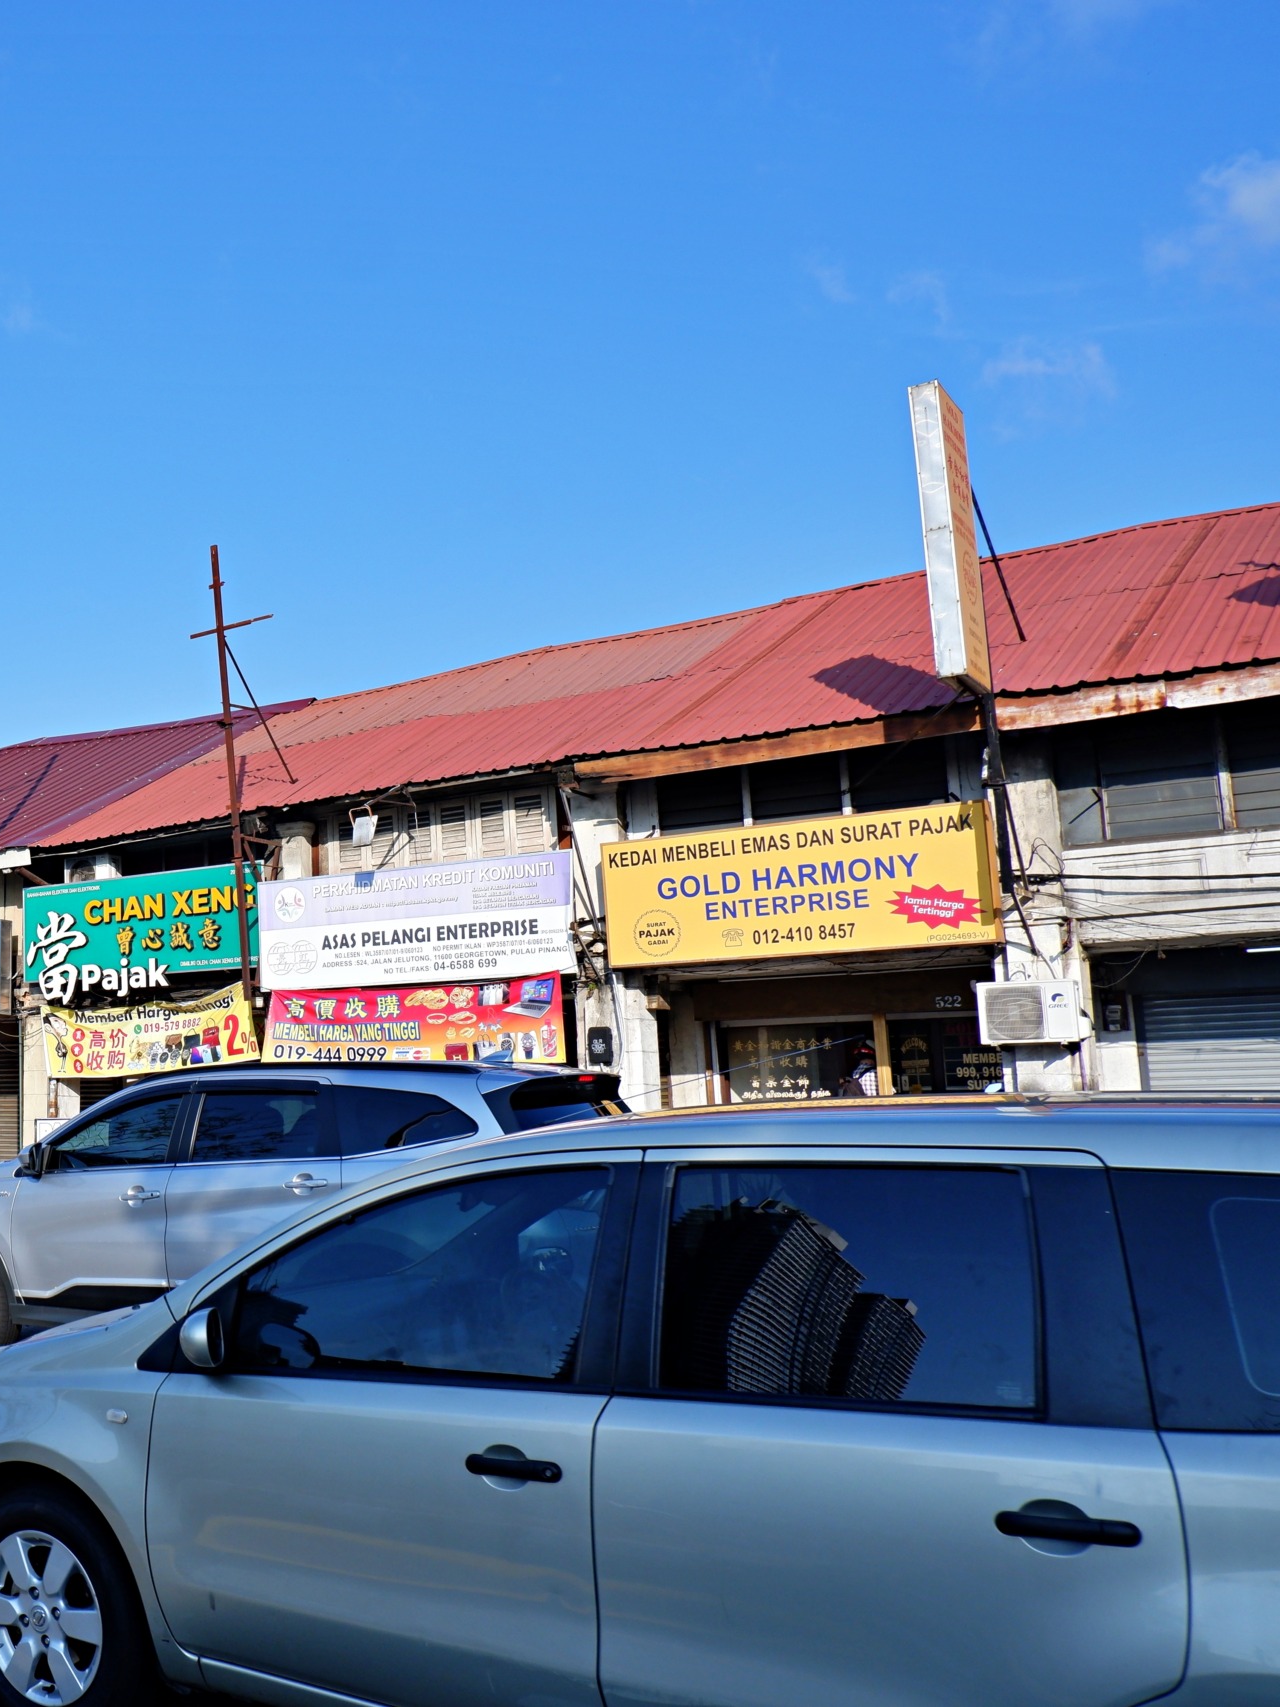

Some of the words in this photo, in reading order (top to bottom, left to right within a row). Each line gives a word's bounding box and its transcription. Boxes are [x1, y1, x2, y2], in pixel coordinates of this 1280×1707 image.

[608, 848, 657, 868] KEDAI
[662, 840, 736, 862] MENBELI
[741, 834, 790, 854] EMAS
[796, 828, 834, 848] DAN
[840, 821, 902, 844] SURAT
[909, 813, 972, 836] PAJAK
[312, 876, 418, 898] PERKHIDMATAN
[422, 870, 476, 888] KREDIT
[479, 862, 554, 882] KOMUNITI
[657, 870, 740, 900] GOLD
[752, 853, 919, 891] HARMONY
[84, 893, 164, 924] CHAN
[172, 884, 254, 916] XENG
[705, 888, 870, 921] ENTERPRISE
[904, 896, 931, 906] Jamin
[934, 898, 964, 910] Harga
[912, 905, 955, 918] Tertinggi
[116, 918, 220, 956] 曾心誠意
[322, 933, 356, 950] ASAS
[362, 926, 430, 947] PELANGI
[436, 918, 538, 942] ENTERPRISE
[638, 928, 676, 938] PAJAK
[752, 926, 812, 944] 012-410
[819, 923, 856, 940] 8457
[926, 932, 990, 942] (PG0254693-V)
[27, 911, 87, 1005] 當
[434, 960, 474, 971] 04-6588
[478, 958, 497, 968] 699
[82, 958, 169, 997] Pajak
[284, 994, 401, 1020] 高價收購
[935, 995, 962, 1008] 522
[144, 1022, 180, 1033] 019-579
[182, 1017, 202, 1030] 8882
[274, 1022, 318, 1040] MEMBELI
[320, 1022, 354, 1042] HARGA
[355, 1023, 382, 1042] YANG
[384, 1022, 420, 1040] TINGGI
[89, 1028, 128, 1049] 高价
[86, 1050, 126, 1070] 收购
[274, 1045, 342, 1061] 019-444
[347, 1046, 387, 1061] 0999
[956, 1067, 980, 1079] 999,
[982, 1066, 1003, 1077] 916
